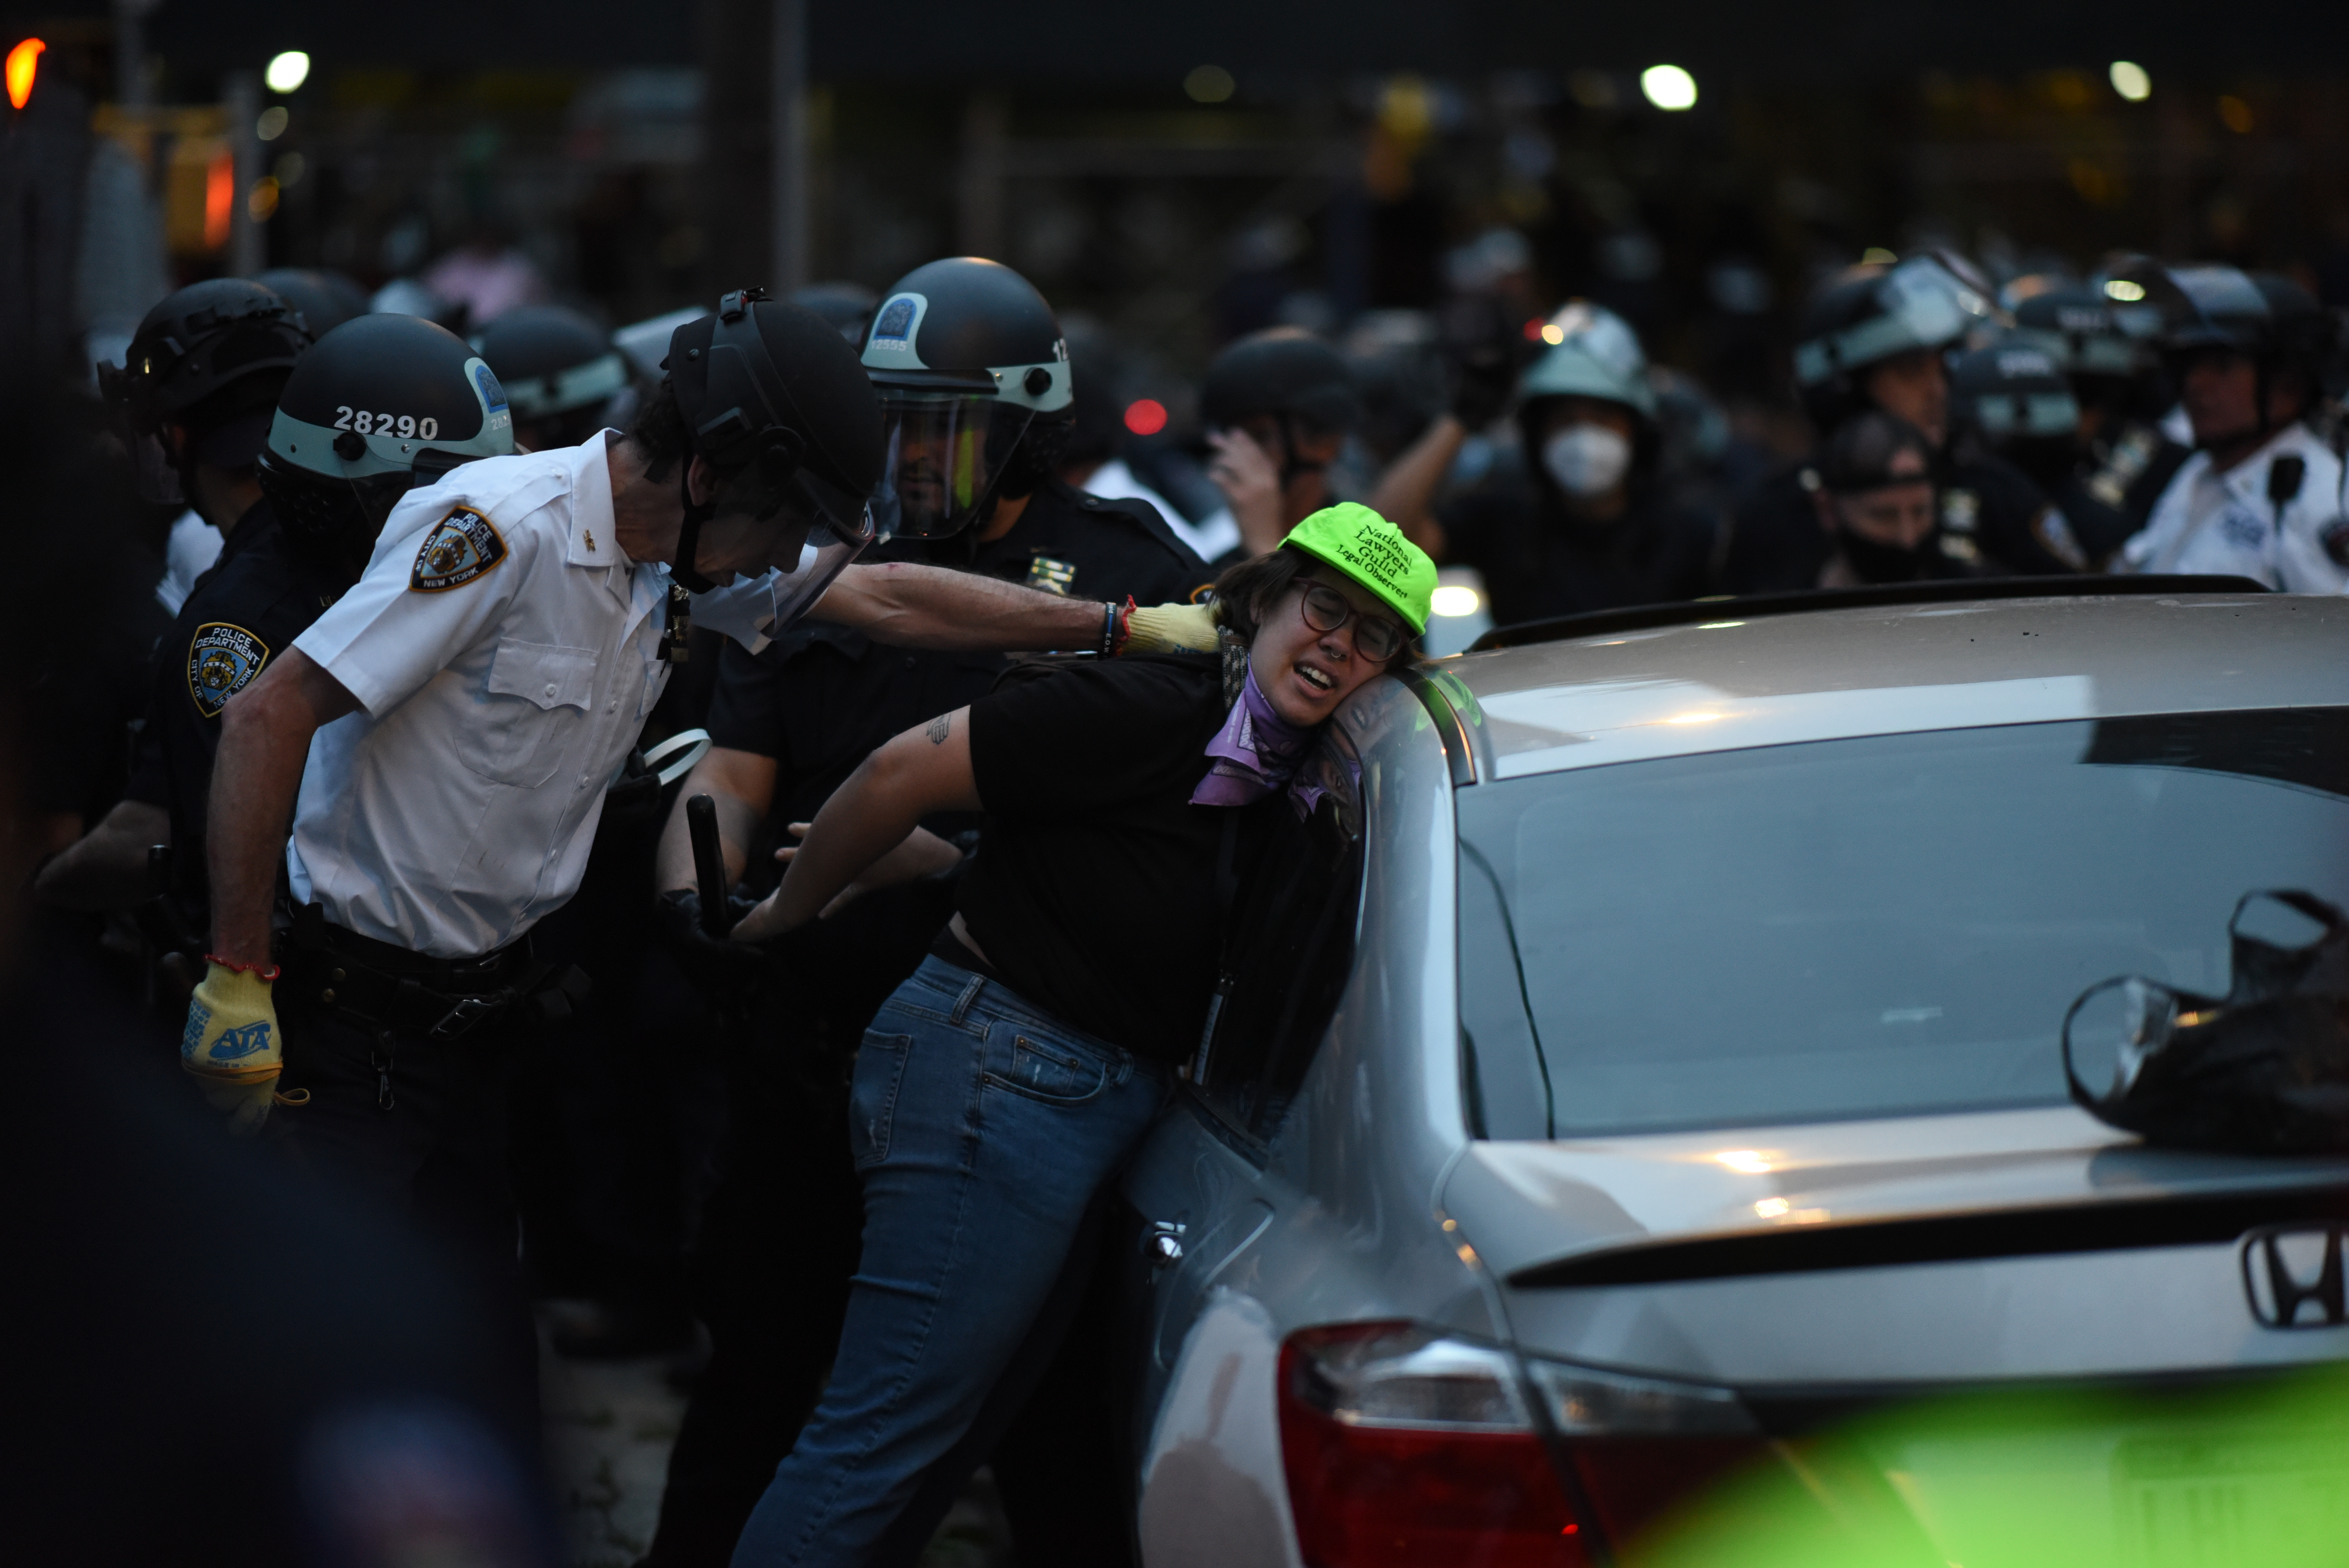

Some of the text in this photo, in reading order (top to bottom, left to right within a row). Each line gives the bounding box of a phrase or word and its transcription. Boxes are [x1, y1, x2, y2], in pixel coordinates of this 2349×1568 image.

[334, 406, 438, 440] 28290
[444, 517, 493, 562] DEPARTMENT
[462, 513, 493, 542] POLICE
[1336, 544, 1365, 566] Legal
[1354, 531, 1409, 575] Lawyers
[1361, 524, 1412, 568] National
[1359, 546, 1397, 578] Guild
[423, 567, 479, 588] NEW YORK
[194, 637, 260, 665] DEPARTMENT
[212, 627, 252, 647] POLICE
[194, 686, 203, 699] OF
[213, 667, 254, 709] NEW YORK
[213, 1027, 270, 1053] ATA
